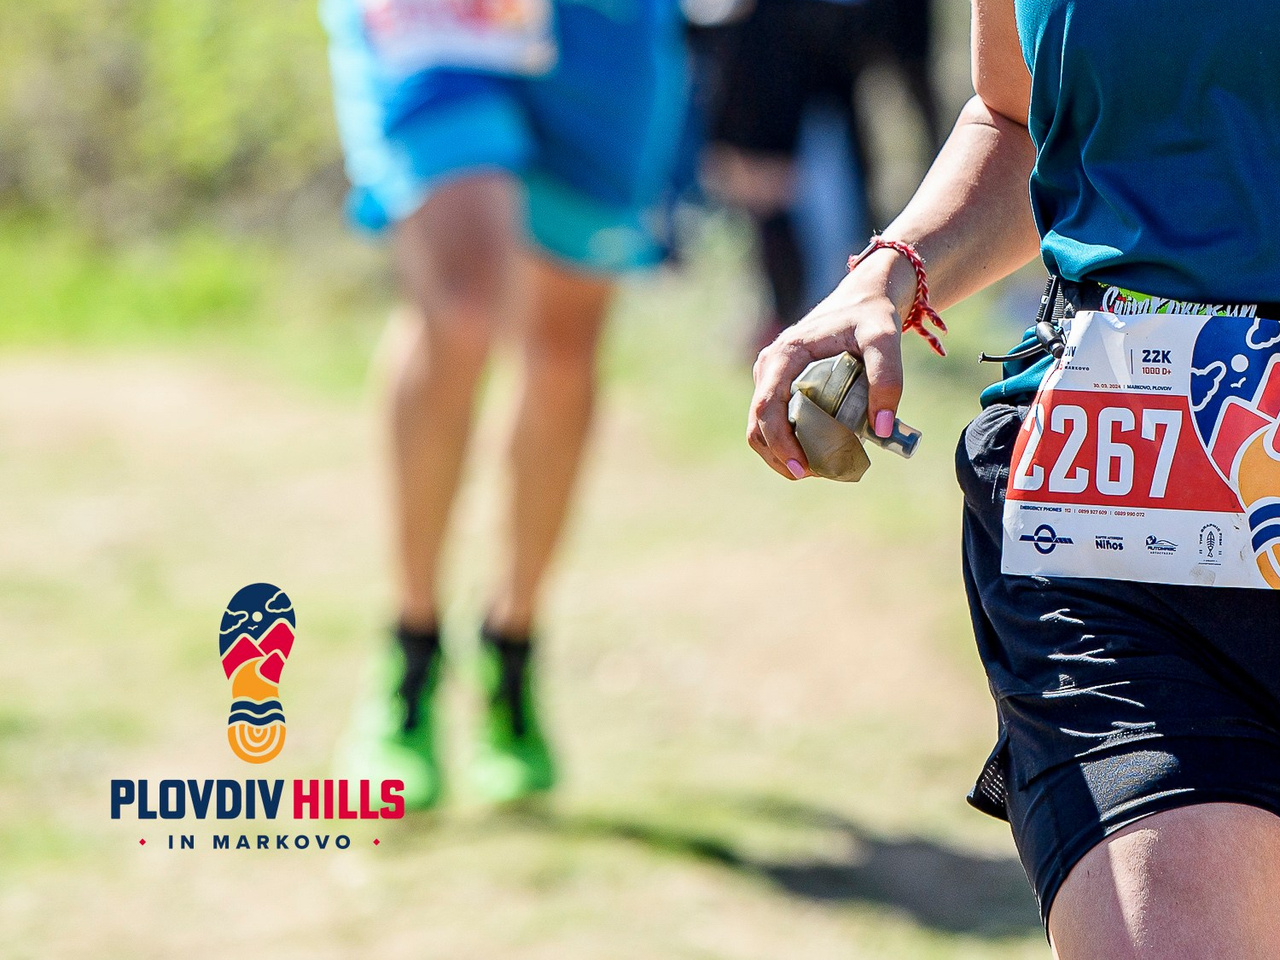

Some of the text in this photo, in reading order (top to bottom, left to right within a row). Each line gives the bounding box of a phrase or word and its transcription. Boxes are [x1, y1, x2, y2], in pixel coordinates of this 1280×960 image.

[1142, 349, 1172, 364] 22K
[1142, 367, 1172, 375] 1000 D+
[1013, 403, 1183, 499] 2267
